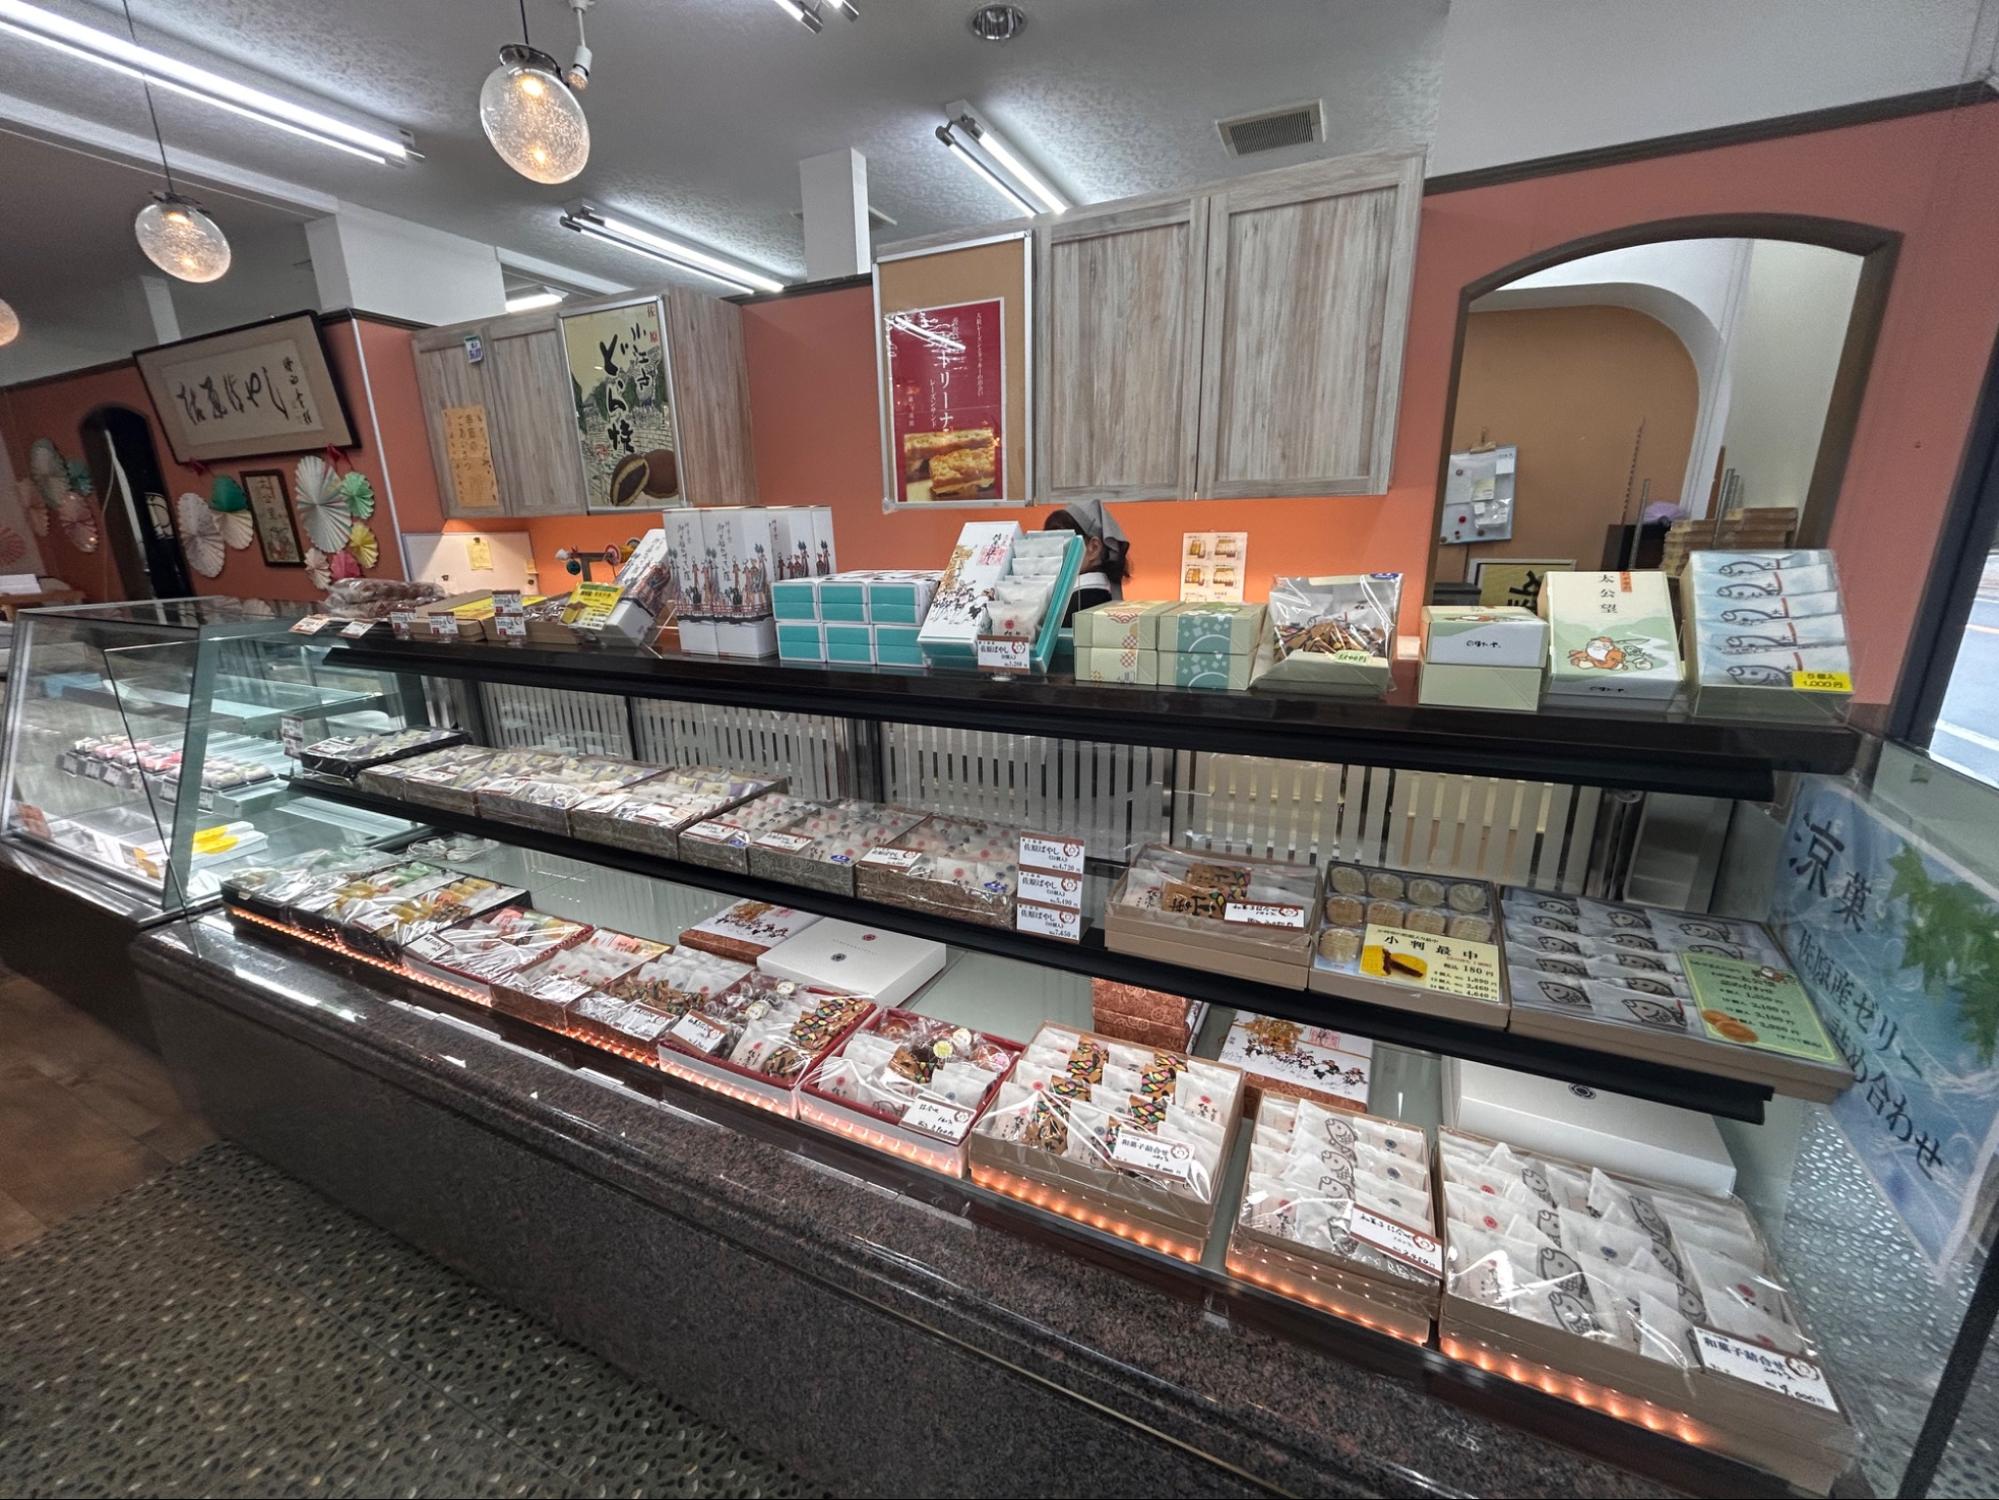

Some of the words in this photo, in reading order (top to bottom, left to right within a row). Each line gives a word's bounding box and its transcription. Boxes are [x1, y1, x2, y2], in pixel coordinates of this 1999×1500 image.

[1600, 574, 1618, 613] 太公望
[1024, 843, 1060, 855] 佐原ばやし
[1022, 877, 1058, 890] 佐原ばやし
[1789, 813, 1872, 932] 涼菓
[1021, 910, 1055, 922] 佐原ばやし
[1385, 935, 1479, 960] 小判最中
[1799, 928, 1923, 1079] 佐原産ゼリー
[1703, 1337, 1785, 1371] 和菓子詰合せ
